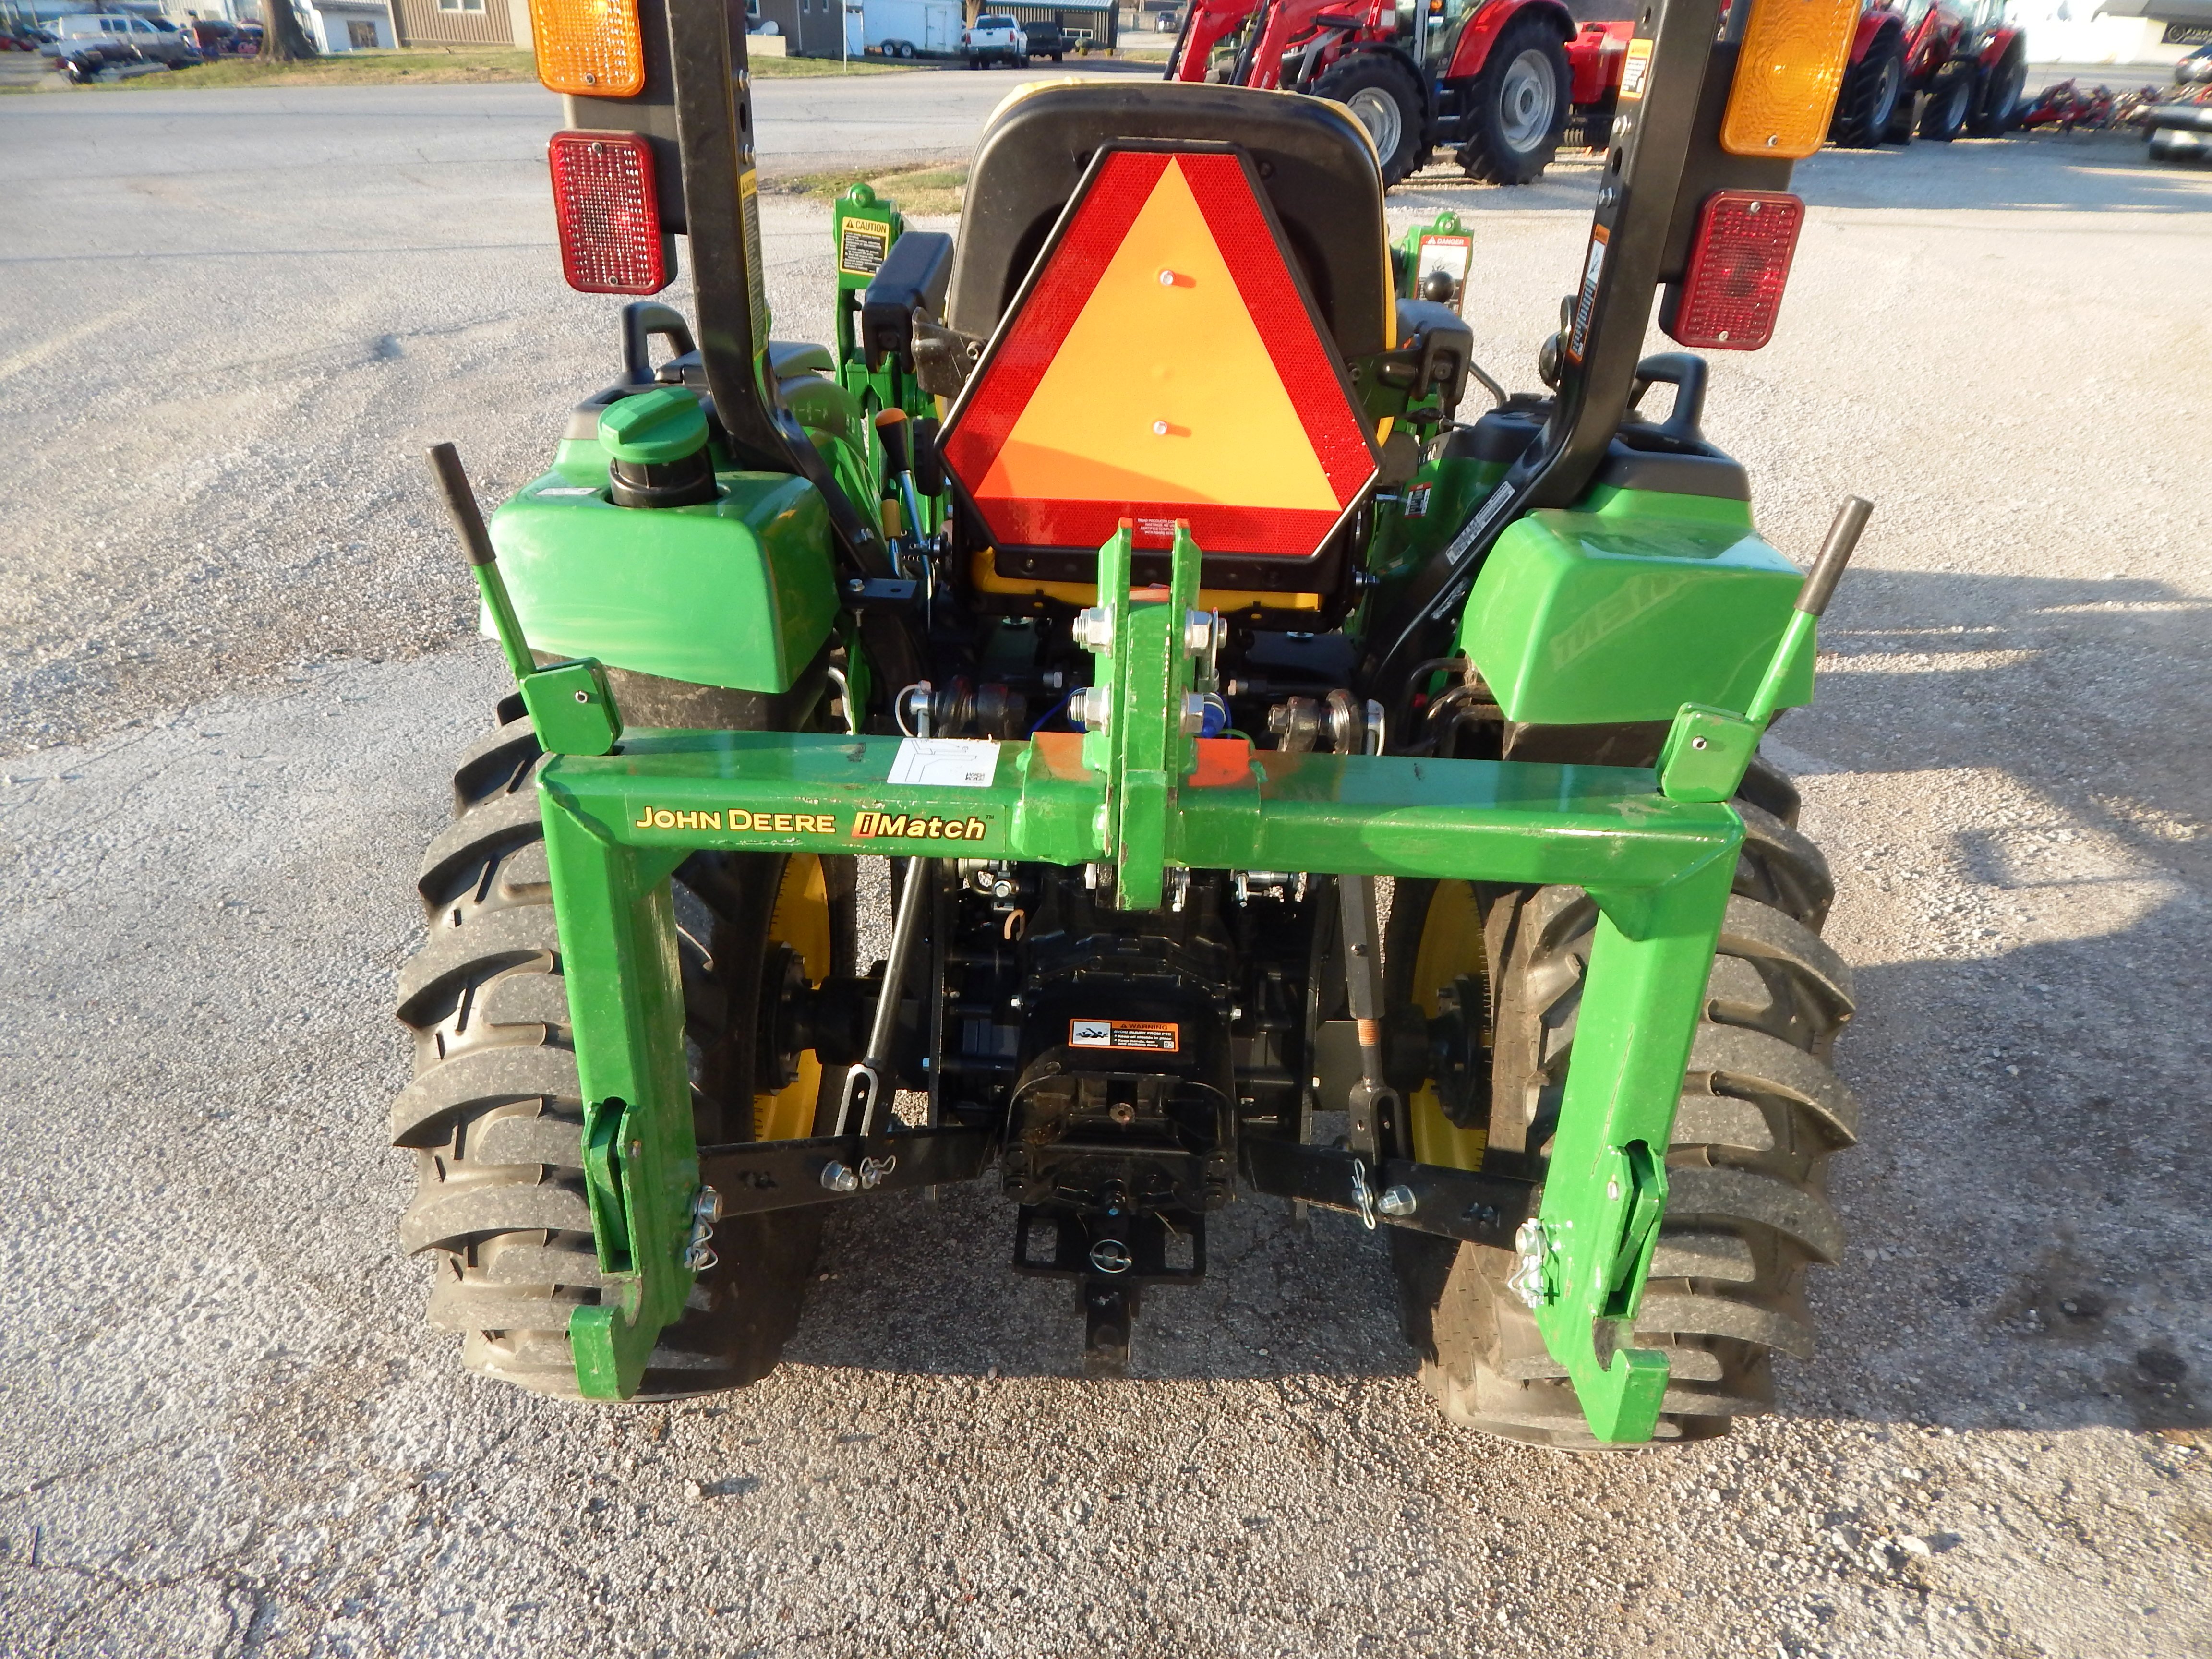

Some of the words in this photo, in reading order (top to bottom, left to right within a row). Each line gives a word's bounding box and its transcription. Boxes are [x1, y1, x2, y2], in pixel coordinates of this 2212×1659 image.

[855, 220, 887, 233] CAUTION
[636, 806, 721, 830] JOHN
[728, 808, 836, 834] DEERE
[852, 811, 985, 841] iMatch
